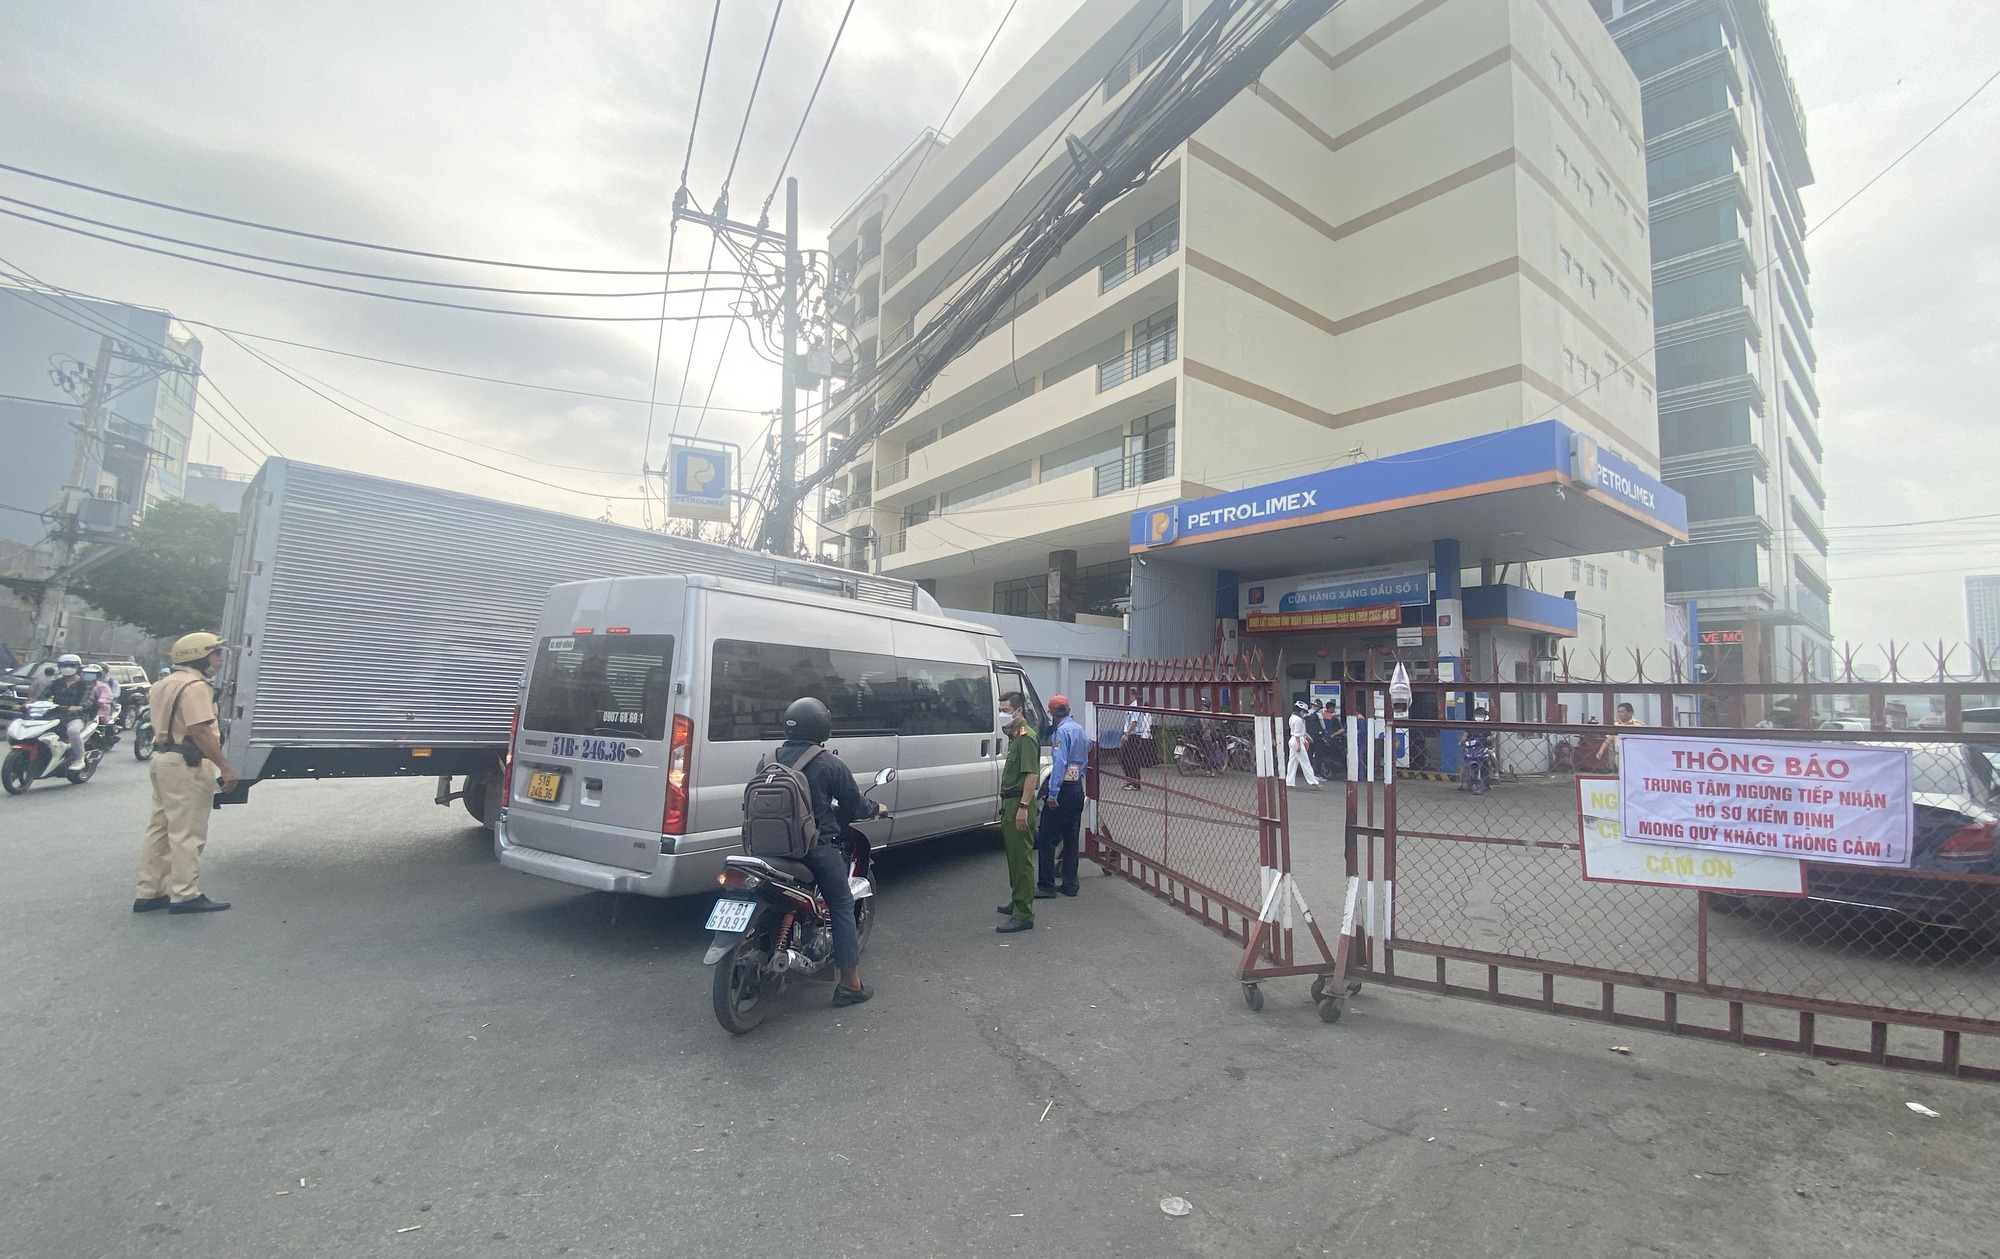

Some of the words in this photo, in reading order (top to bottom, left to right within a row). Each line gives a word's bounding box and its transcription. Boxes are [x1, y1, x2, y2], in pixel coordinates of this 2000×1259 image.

[676, 496, 725, 507] PETROLIMEX
[1598, 464, 1655, 509] PETROLIMEX
[1188, 490, 1317, 529] PETROLIMEX
[1309, 590, 1336, 602] HÀNG
[1395, 580, 1411, 594] SỐ
[1414, 583, 1419, 592] 1
[1672, 748, 1774, 774] THÔNG
[1785, 753, 1849, 779] BÁO
[538, 775, 551, 786] 51B
[1643, 778, 1692, 794] TRUNG
[1697, 779, 1730, 797] TÂM
[1736, 784, 1792, 802] NGƯNG
[1798, 785, 1833, 804] TIẾP
[1839, 790, 1886, 810] NHẬN
[1591, 793, 1618, 810] NG
[1695, 800, 1716, 819] HỒ
[1721, 805, 1742, 821] SƠ
[1747, 804, 1788, 825] KIỂM
[1793, 811, 1834, 830] ĐỊNH
[1639, 821, 1684, 838] MONG
[1689, 825, 1719, 841] QUÝ
[1723, 828, 1778, 847] KHÁCH
[1782, 833, 1837, 853] THÔNG
[1843, 835, 1881, 857] CẢM
[1886, 843, 1892, 858] !
[709, 915, 747, 930] 619.97
